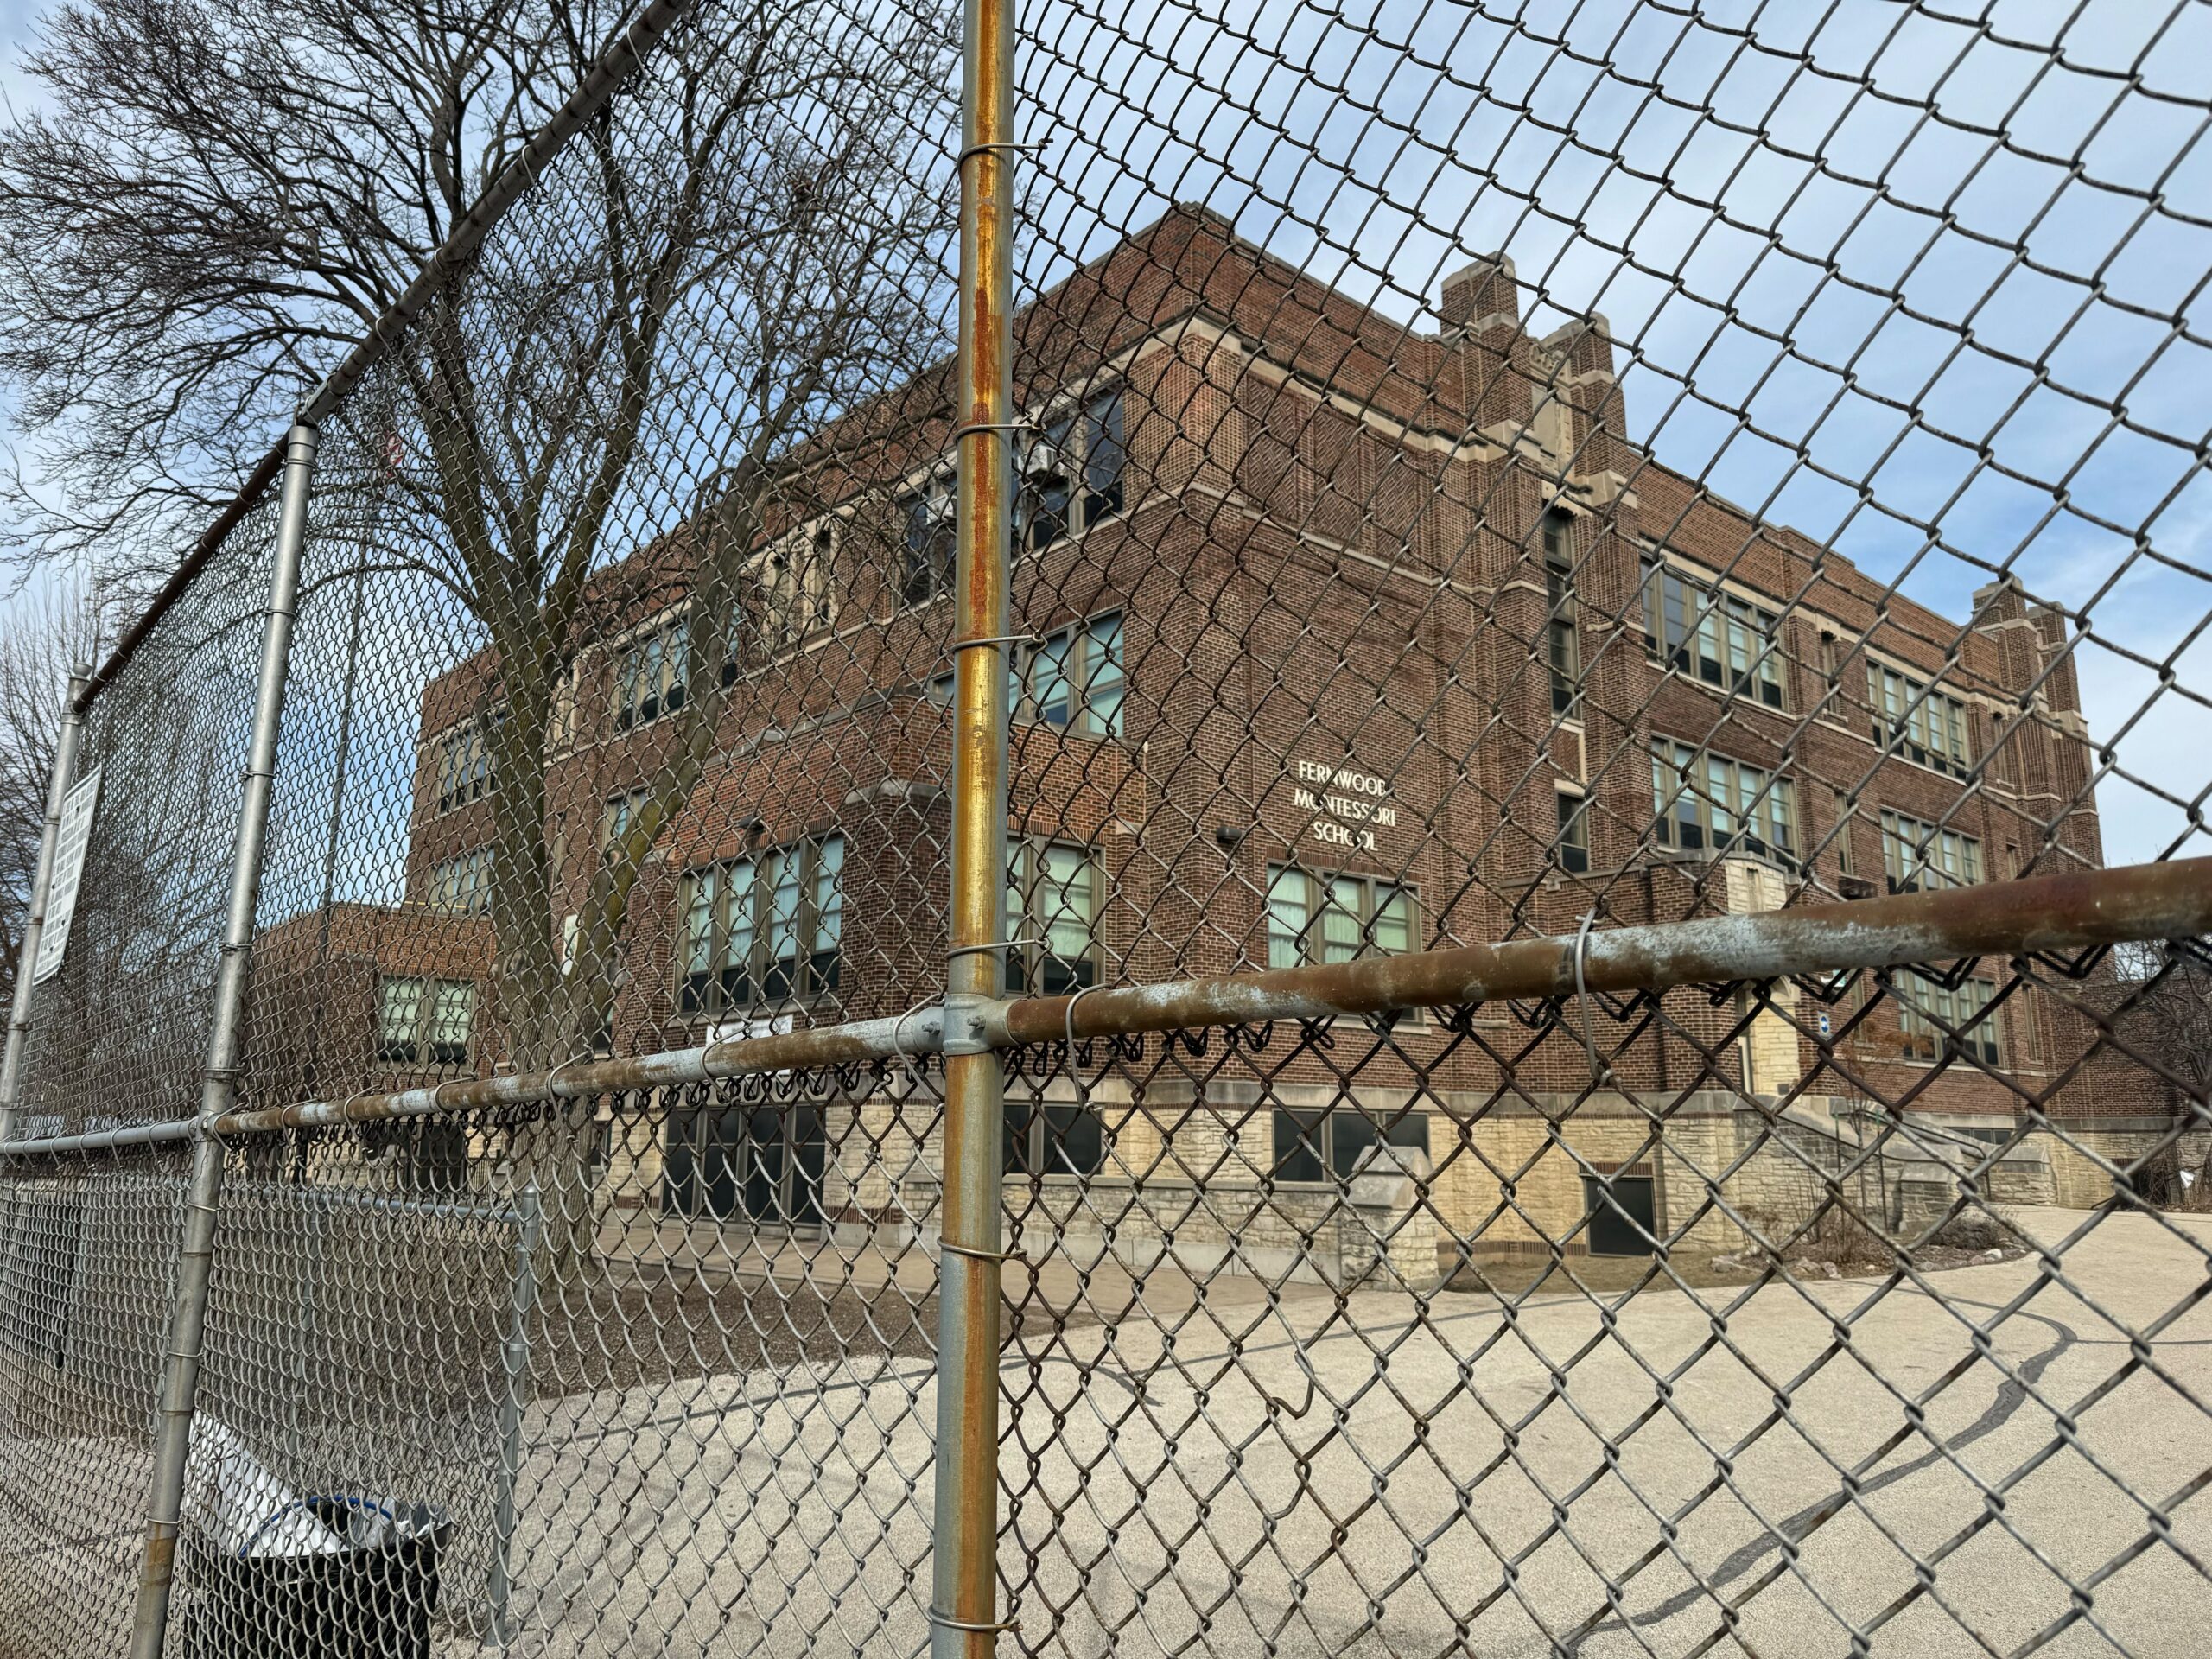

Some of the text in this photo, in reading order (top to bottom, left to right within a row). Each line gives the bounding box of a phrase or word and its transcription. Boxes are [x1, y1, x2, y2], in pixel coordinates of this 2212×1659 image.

[1299, 760, 1387, 796] FERNWOOD
[1294, 788, 1395, 827] MONTESSORI
[1313, 821, 1378, 851] SCHOOL
